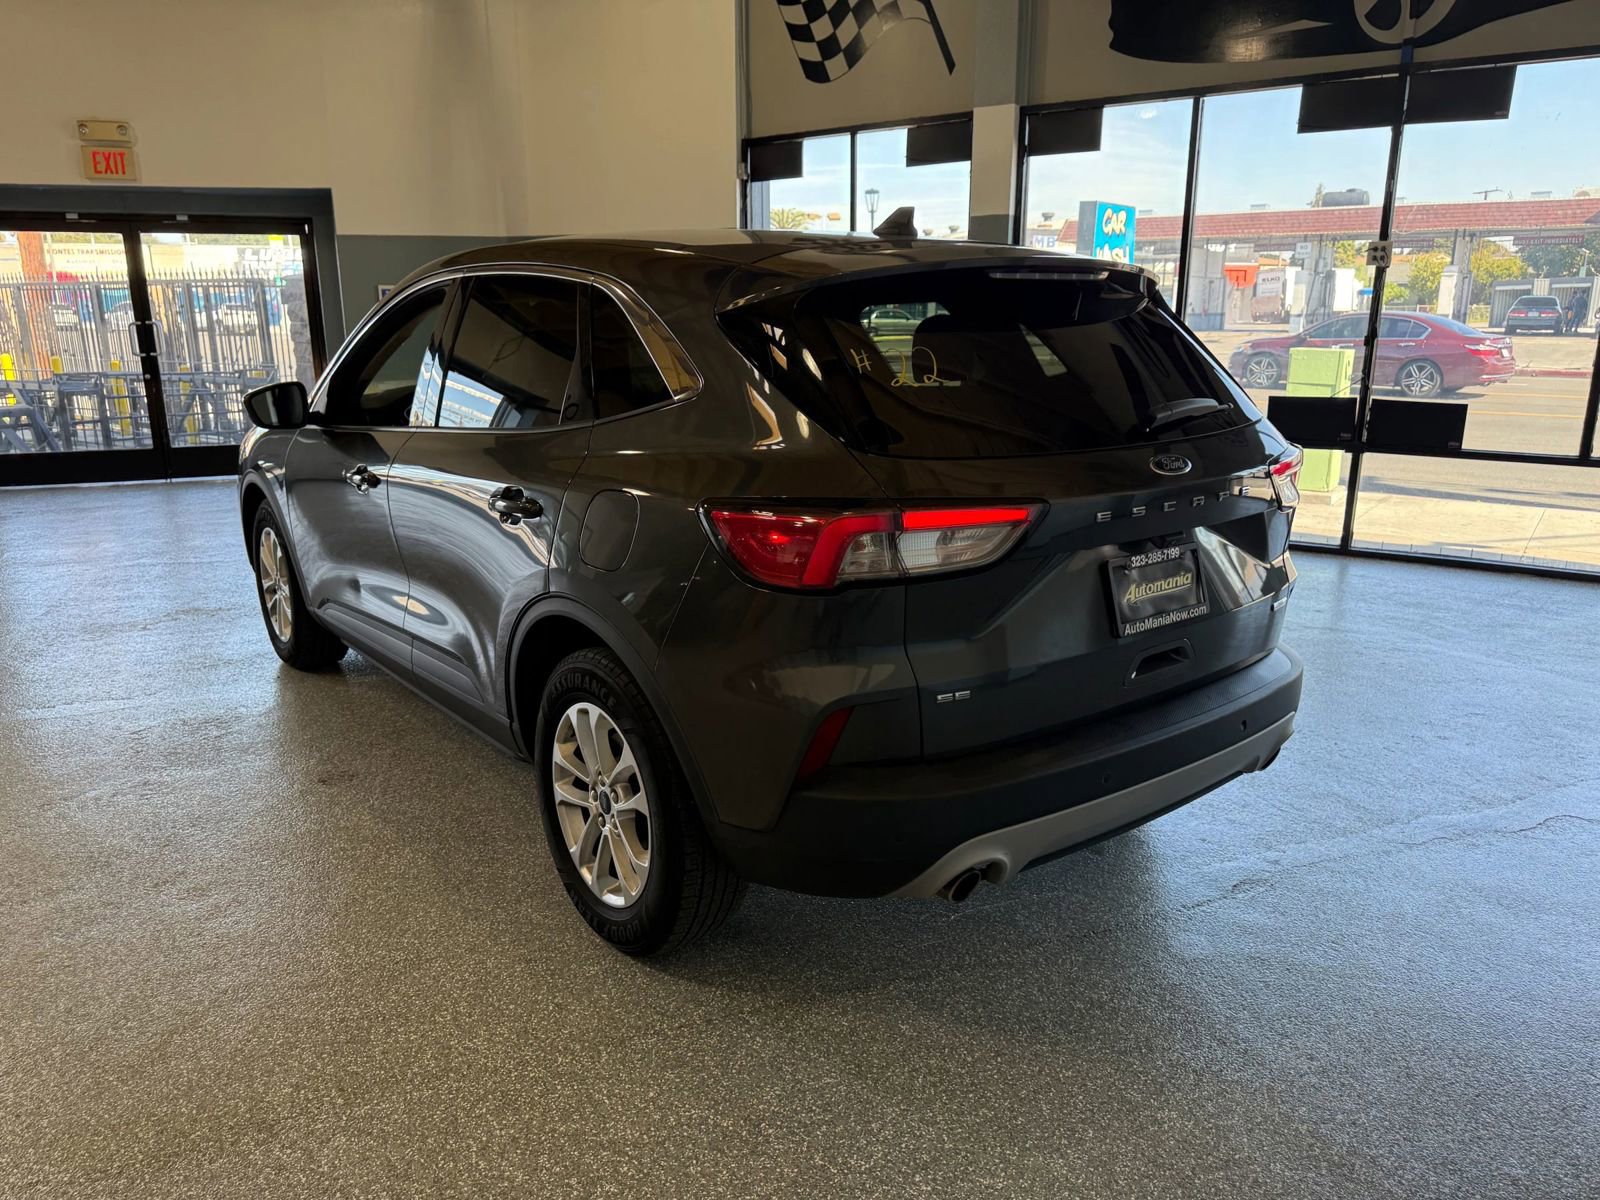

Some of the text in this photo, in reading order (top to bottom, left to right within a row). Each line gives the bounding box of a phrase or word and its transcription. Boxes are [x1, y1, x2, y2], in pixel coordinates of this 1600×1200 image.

[91, 150, 126, 175] EXIT
[1102, 207, 1127, 234] CAR
[1096, 486, 1250, 523] ESCAPE
[1131, 547, 1180, 568] 323-285-7199
[1124, 572, 1193, 603] Automania
[1124, 605, 1207, 636] AutoManiaNow.com
[936, 690, 971, 704] SE
